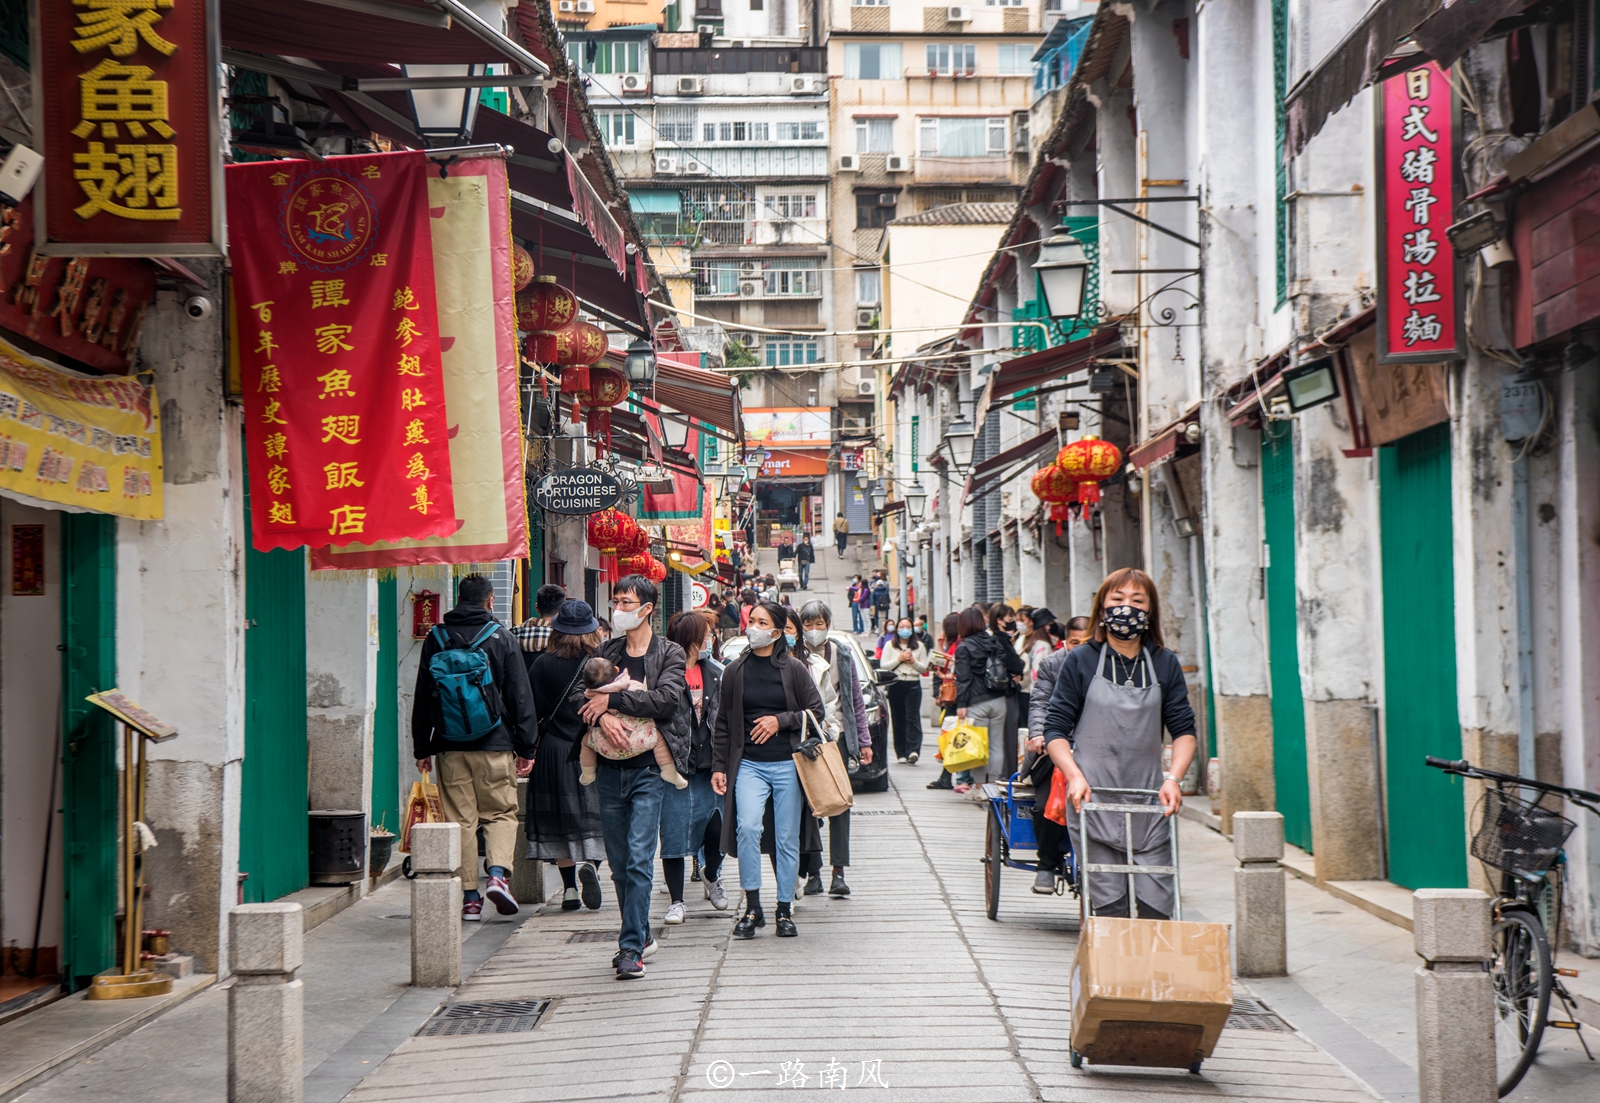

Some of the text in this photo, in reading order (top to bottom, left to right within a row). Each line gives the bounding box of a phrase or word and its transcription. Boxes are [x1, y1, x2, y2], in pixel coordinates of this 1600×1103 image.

[70, 0, 184, 221] 家魚翅
[292, 223, 307, 244] TAM
[305, 243, 325, 258] KAH
[357, 216, 366, 234] FIN
[1502, 386, 1537, 398] 2371
[309, 279, 367, 536] 譚家魚翅飯店
[764, 459, 791, 468] mart
[551, 474, 603, 485] DRAGON
[536, 485, 617, 498] PORTUGUESE
[552, 497, 601, 509] CUISINE
